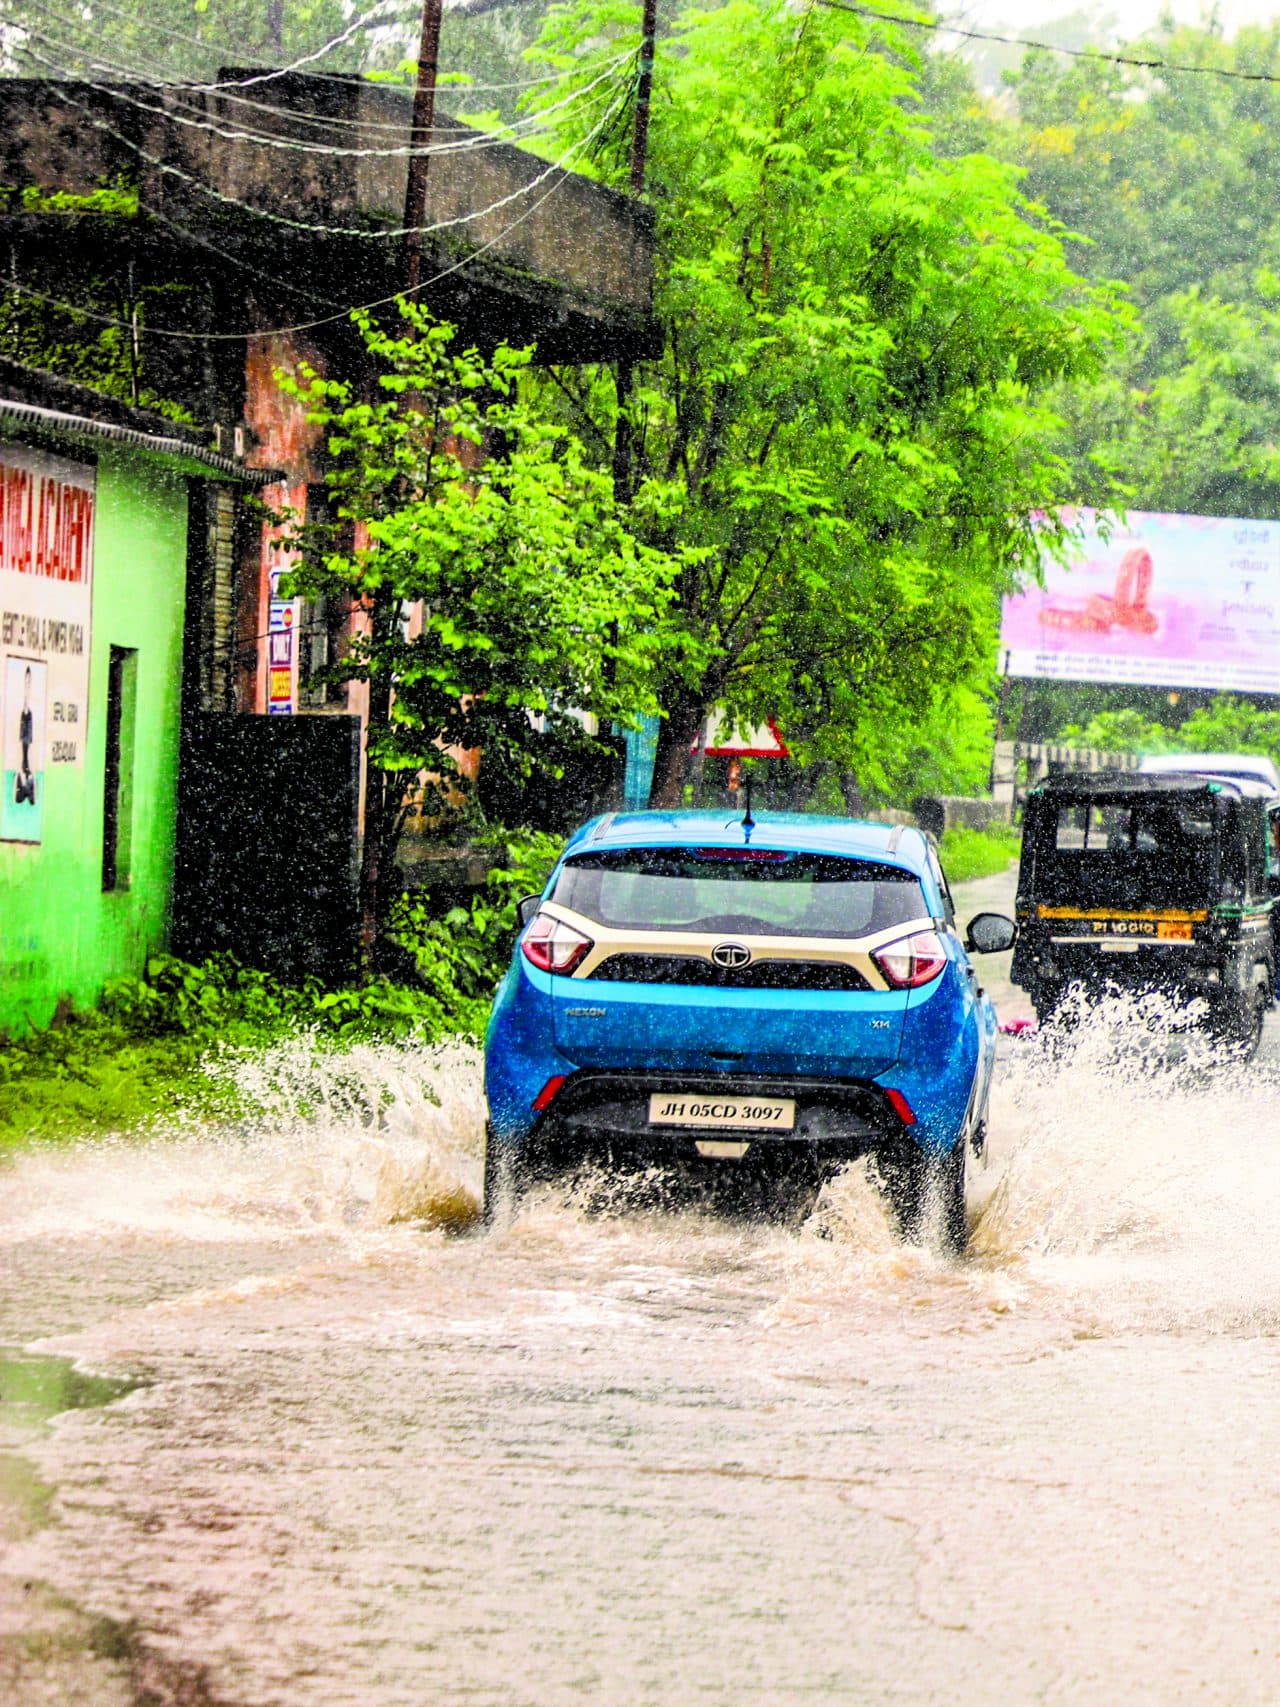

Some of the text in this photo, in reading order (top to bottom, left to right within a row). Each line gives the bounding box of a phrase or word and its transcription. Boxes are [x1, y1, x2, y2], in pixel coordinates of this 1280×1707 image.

[565, 1007, 607, 1017] NEXON
[872, 1020, 890, 1029] XM
[661, 1103, 783, 1120] JH 05CD 3097
